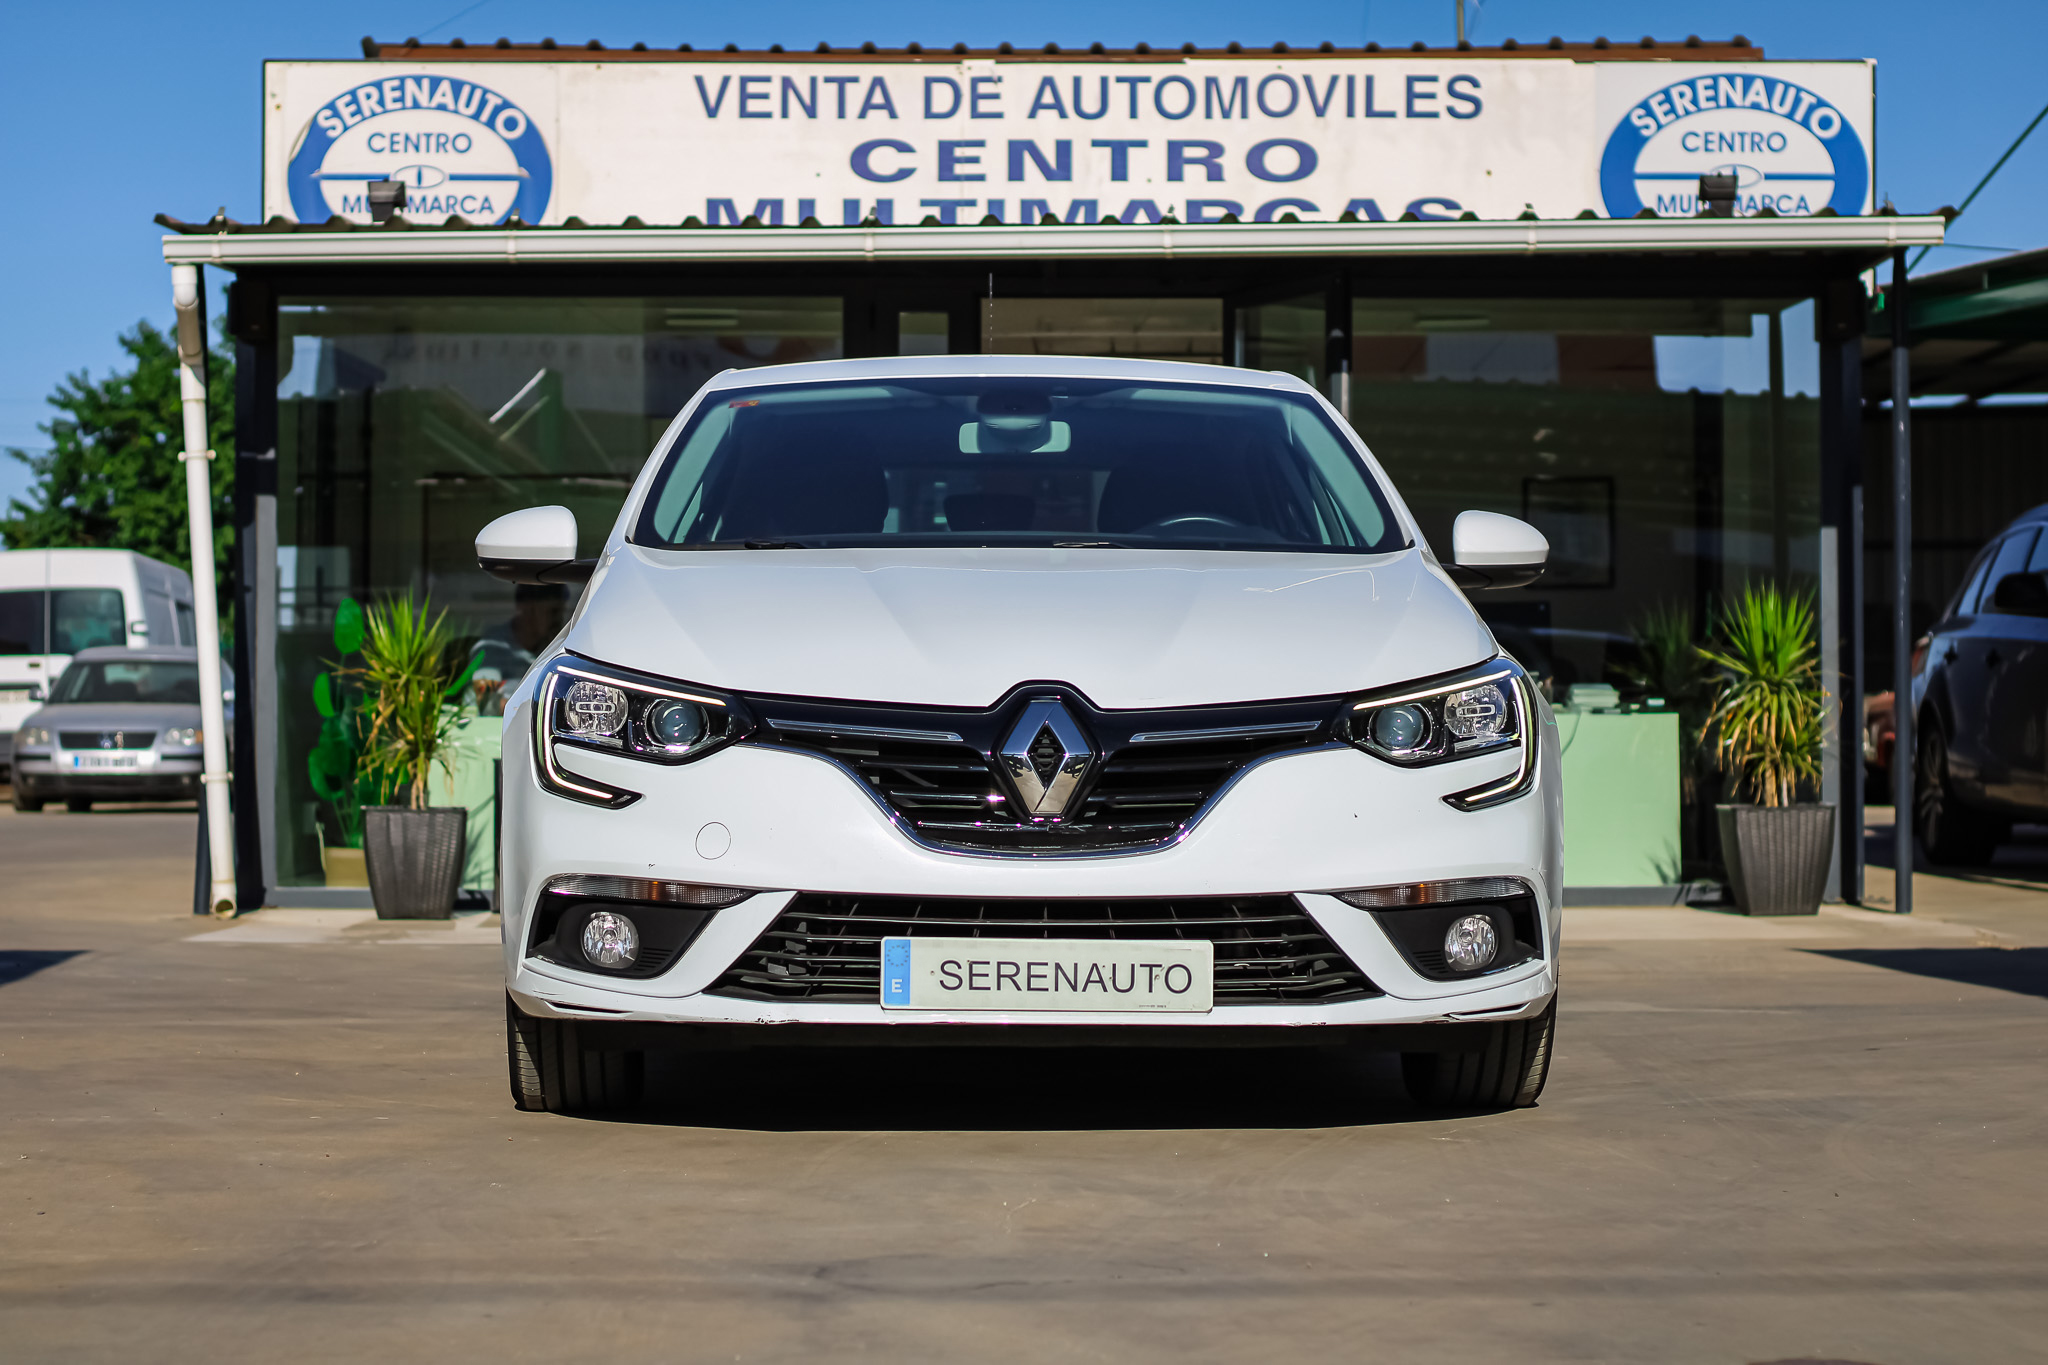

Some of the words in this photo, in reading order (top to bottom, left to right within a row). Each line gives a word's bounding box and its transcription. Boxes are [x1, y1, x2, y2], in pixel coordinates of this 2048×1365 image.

[317, 77, 526, 139] SERENAUTO
[694, 75, 899, 119] VENTA
[923, 76, 1004, 119] DE
[1027, 73, 1483, 120] AUTOMOVILES
[1630, 76, 1841, 139] SERENAUTO
[368, 132, 472, 153] CENTRO
[1682, 131, 1787, 153] CENTRO
[850, 138, 1319, 182] CENTRO
[342, 194, 494, 214] MMARCA
[891, 979, 902, 993] E
[939, 960, 1192, 994] SERENAUTO
